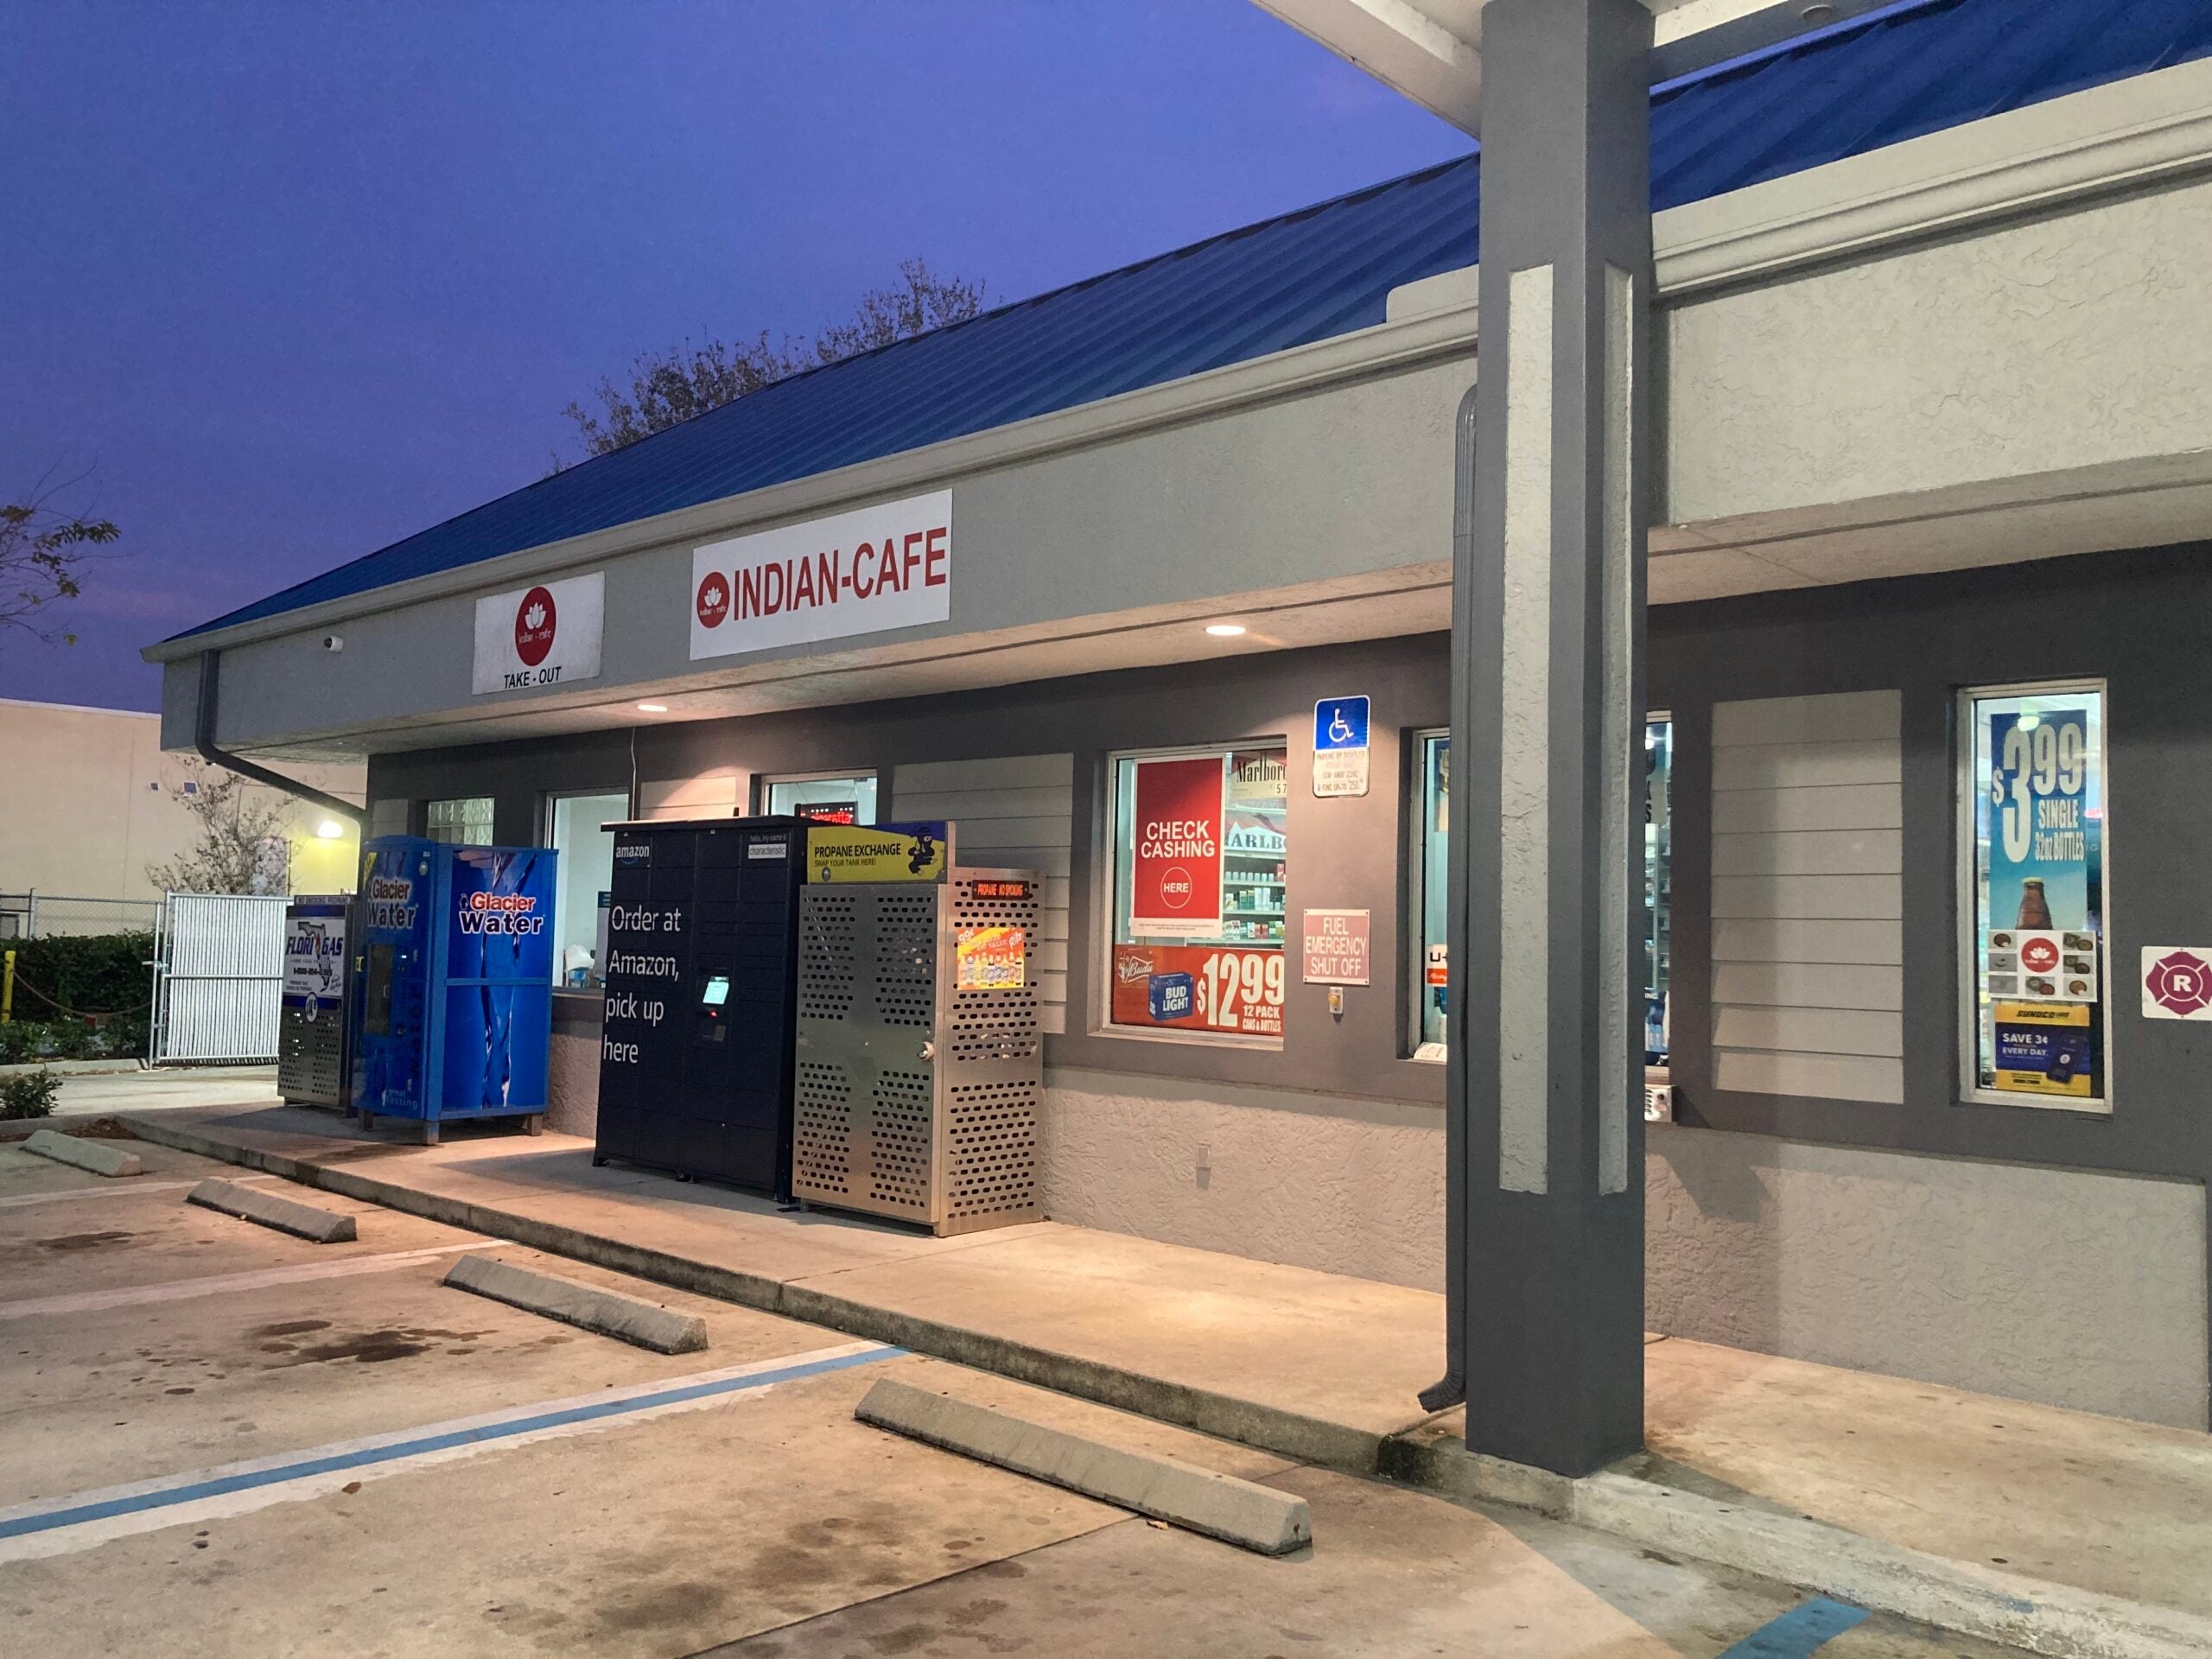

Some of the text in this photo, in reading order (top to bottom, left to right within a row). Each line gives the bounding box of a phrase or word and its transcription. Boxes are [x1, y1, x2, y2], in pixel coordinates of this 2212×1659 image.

[734, 527, 947, 621] INDIAN-CAFE
[504, 671, 531, 689] TAKE
[539, 666, 562, 683] OUT
[2038, 798, 2079, 830] SINGLE
[1146, 820, 1210, 841] CHECK
[1141, 840, 1215, 859] CASHING
[1224, 832, 1287, 849] ARLB
[2053, 831, 2085, 861] BOTTLES
[615, 845, 649, 858] amazon
[814, 843, 901, 858] PROPANE EXCHANGE
[372, 879, 410, 901] Glacier
[1163, 882, 1189, 893] HERE
[469, 892, 536, 912] Glacier
[367, 902, 415, 928] Water
[459, 911, 543, 935] Water
[612, 905, 681, 931] Order at
[1323, 917, 1349, 936] FUEL
[1306, 936, 1367, 956] EMERGENCY
[608, 950, 679, 982] Amazon,
[1311, 957, 1362, 976] SHUT OFF
[1166, 986, 1186, 999] BUD
[2173, 975, 2192, 992] R
[606, 992, 664, 1027] pick up
[1162, 996, 1188, 1012] LIGHT
[1243, 1005, 1280, 1019] 12 PACK
[2016, 1010, 2056, 1019] SUNOCO
[1261, 1020, 1281, 1033] BOTTLES
[603, 1034, 639, 1064] here
[2002, 1033, 2032, 1044] SAVE
[2035, 1034, 2049, 1046] 3¢
[2002, 1046, 2028, 1055] EVERY
